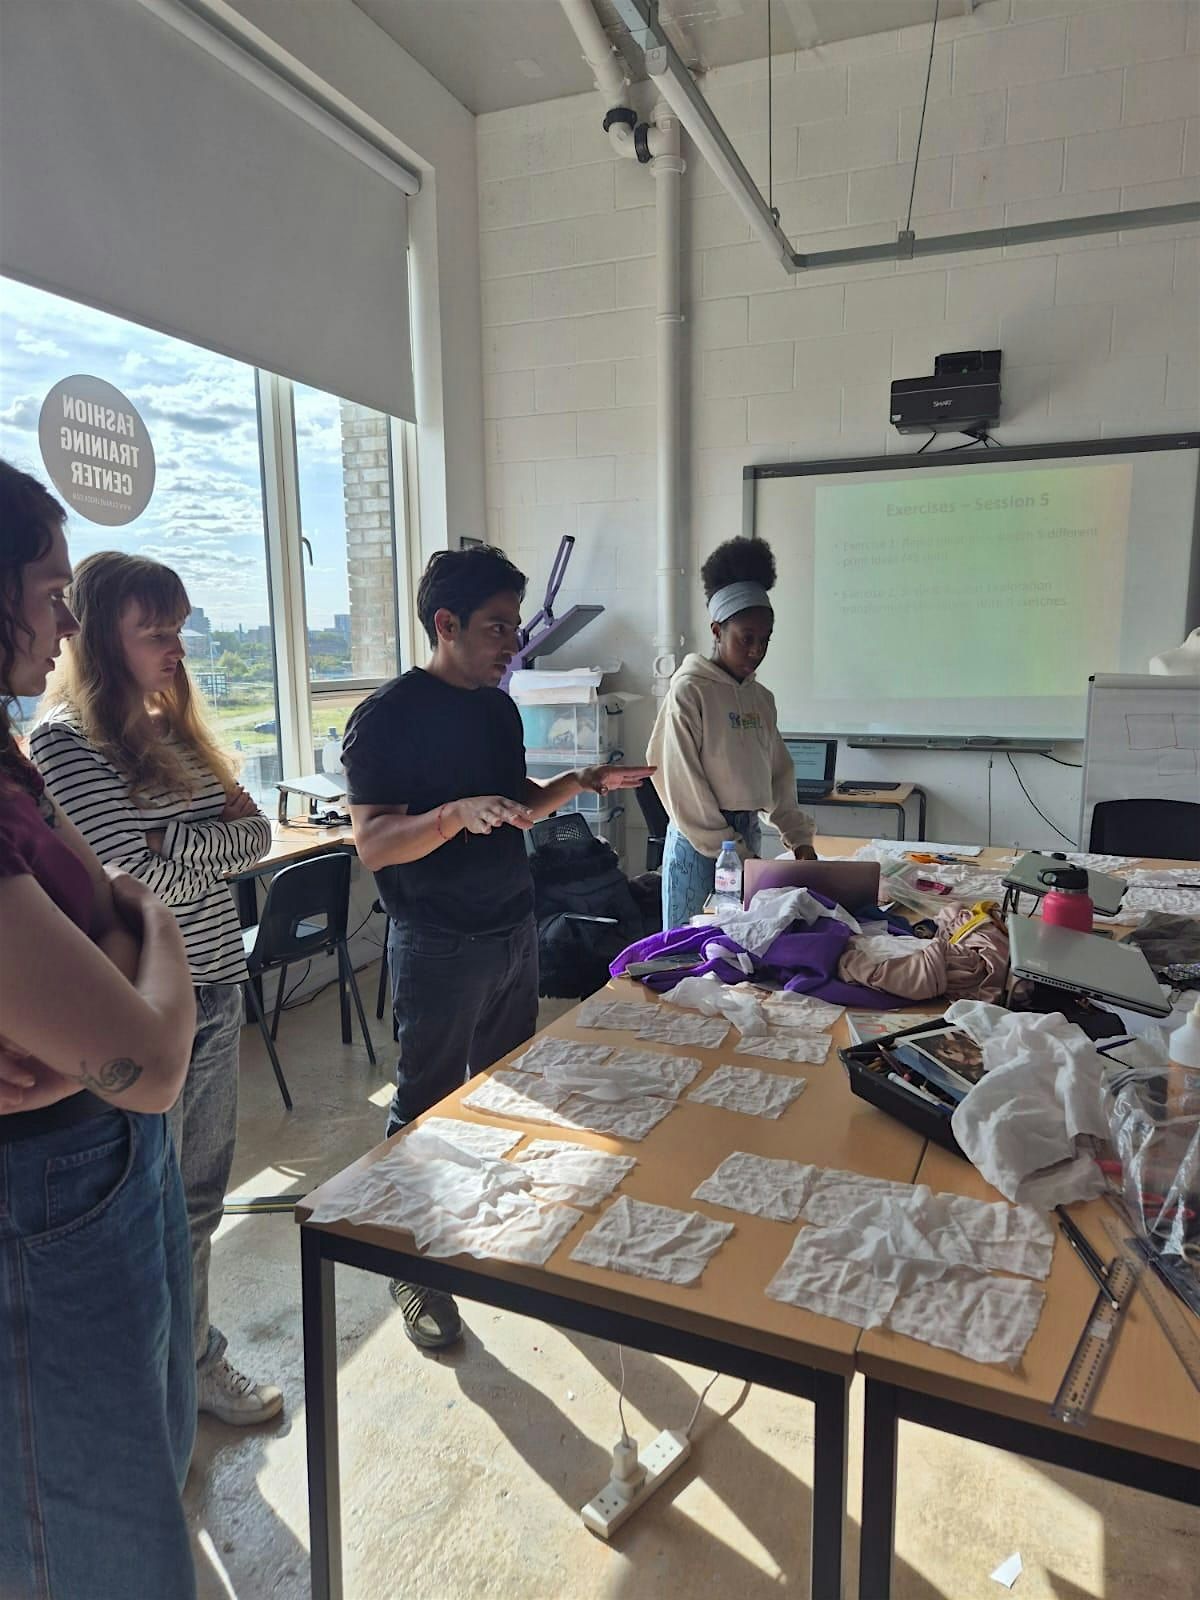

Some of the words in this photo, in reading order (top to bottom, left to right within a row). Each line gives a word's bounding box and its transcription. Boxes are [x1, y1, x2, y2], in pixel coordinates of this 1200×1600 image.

[886, 499, 956, 517] Exercises
[975, 495, 1035, 512] Session
[1039, 492, 1051, 507] 5
